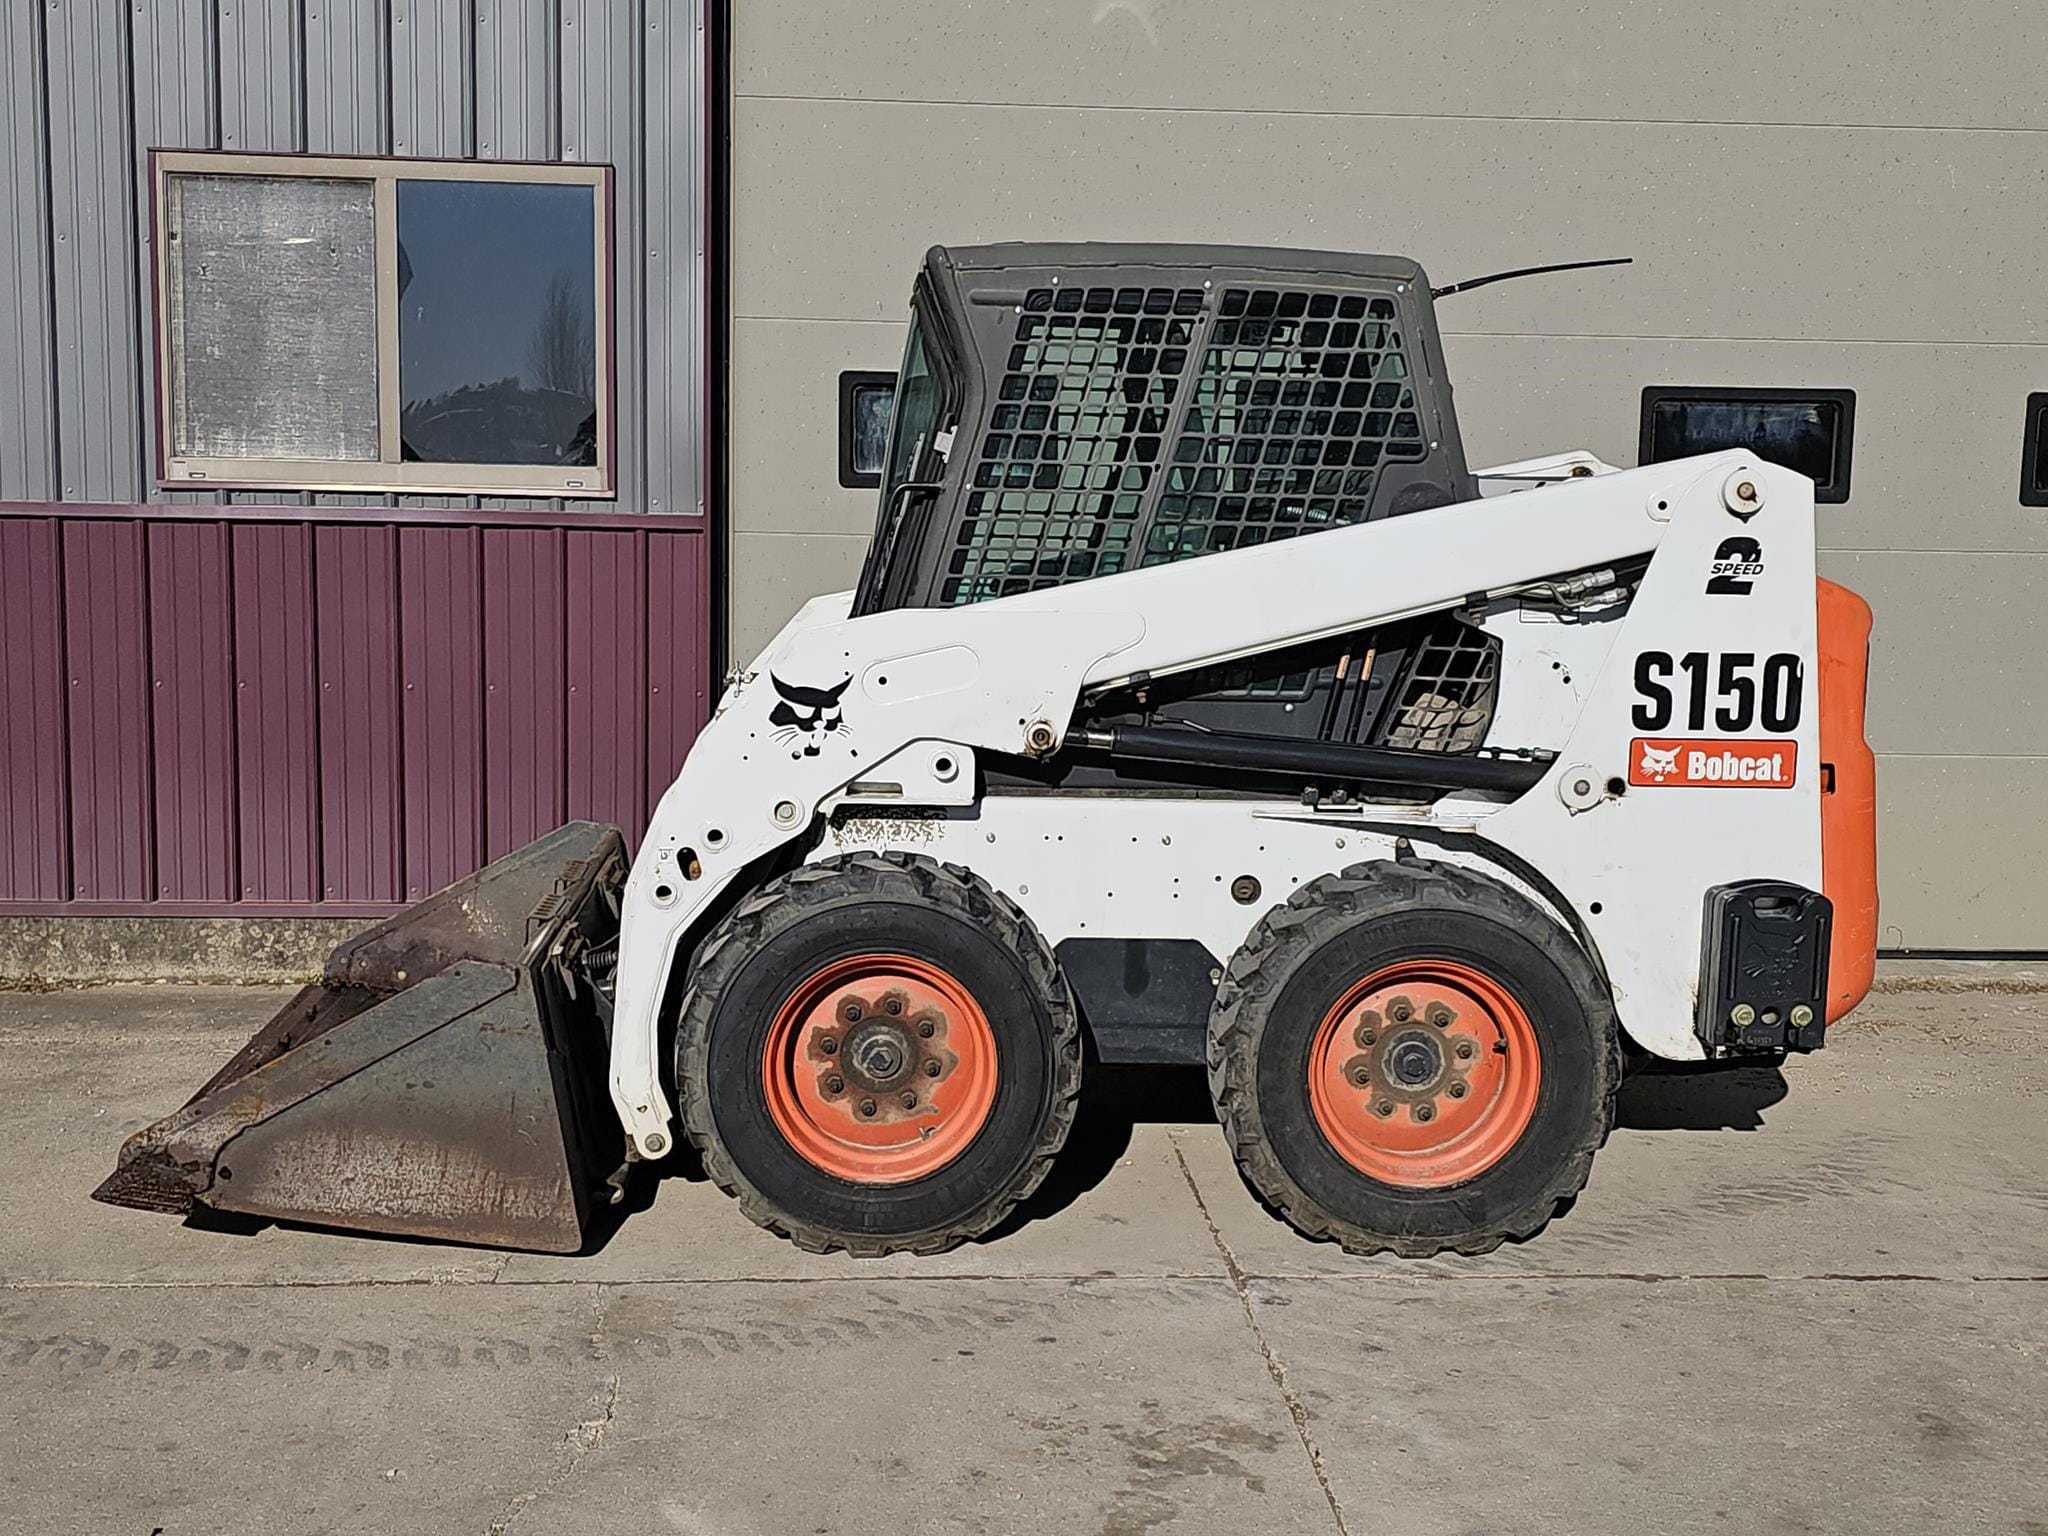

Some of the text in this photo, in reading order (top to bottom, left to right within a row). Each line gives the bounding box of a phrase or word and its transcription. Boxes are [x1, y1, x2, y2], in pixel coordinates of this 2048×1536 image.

[1705, 536, 1763, 596] 2
[1710, 563, 1764, 575] SPEED
[1631, 650, 1804, 733] S150
[1687, 752, 1783, 782] Bobcat
